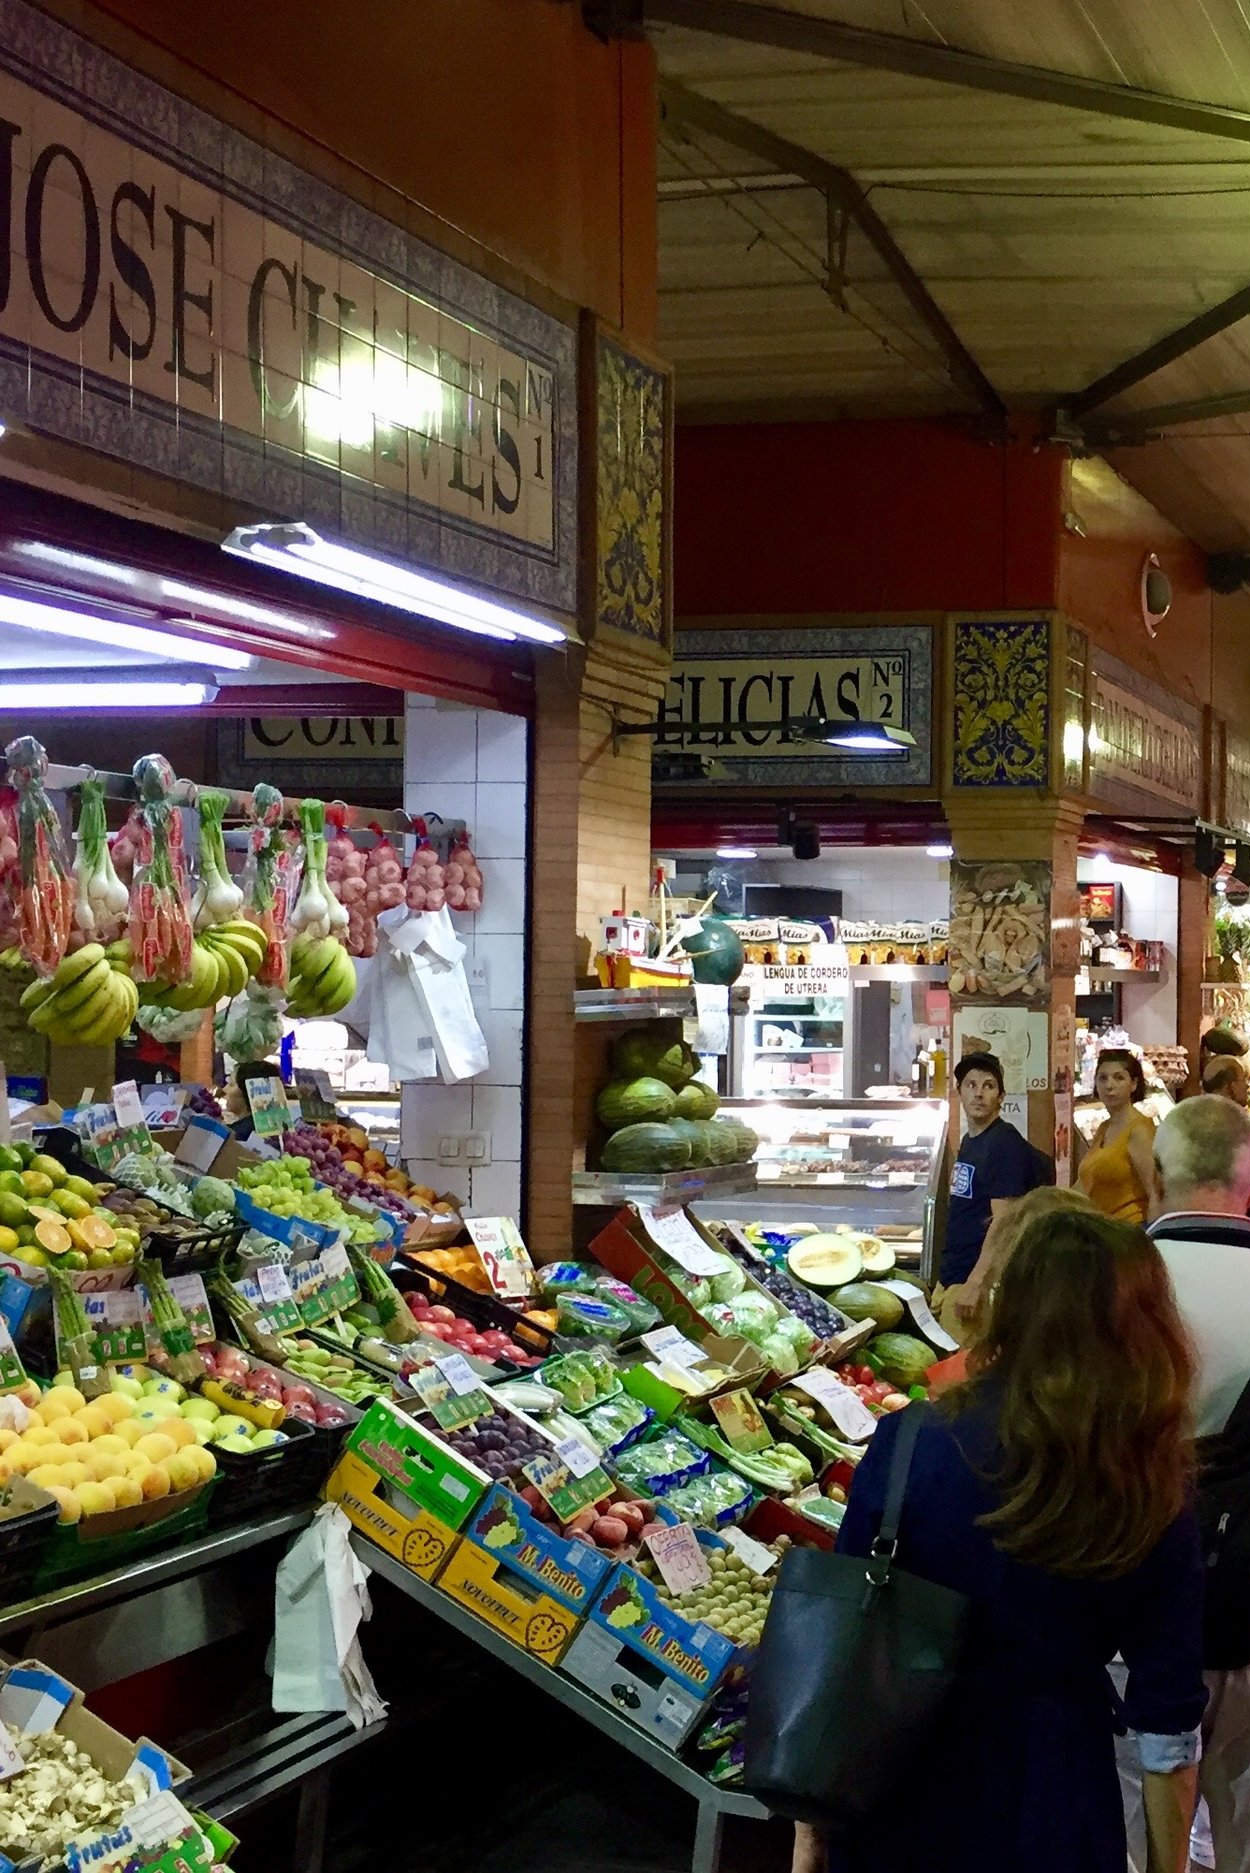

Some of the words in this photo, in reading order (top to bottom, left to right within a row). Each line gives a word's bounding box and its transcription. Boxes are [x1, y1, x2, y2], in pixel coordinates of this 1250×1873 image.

[247, 257, 522, 516] CVES
[879, 693, 894, 719] 2
[764, 967, 796, 980] LENGUA
[798, 968, 809, 979] DE
[811, 968, 848, 979] CORDERO
[784, 983, 795, 995] DE
[797, 983, 827, 995] UTRERA
[536, 1557, 587, 1601] Benito
[659, 1637, 711, 1686] Benito
[66, 1825, 134, 1873] Frutas
